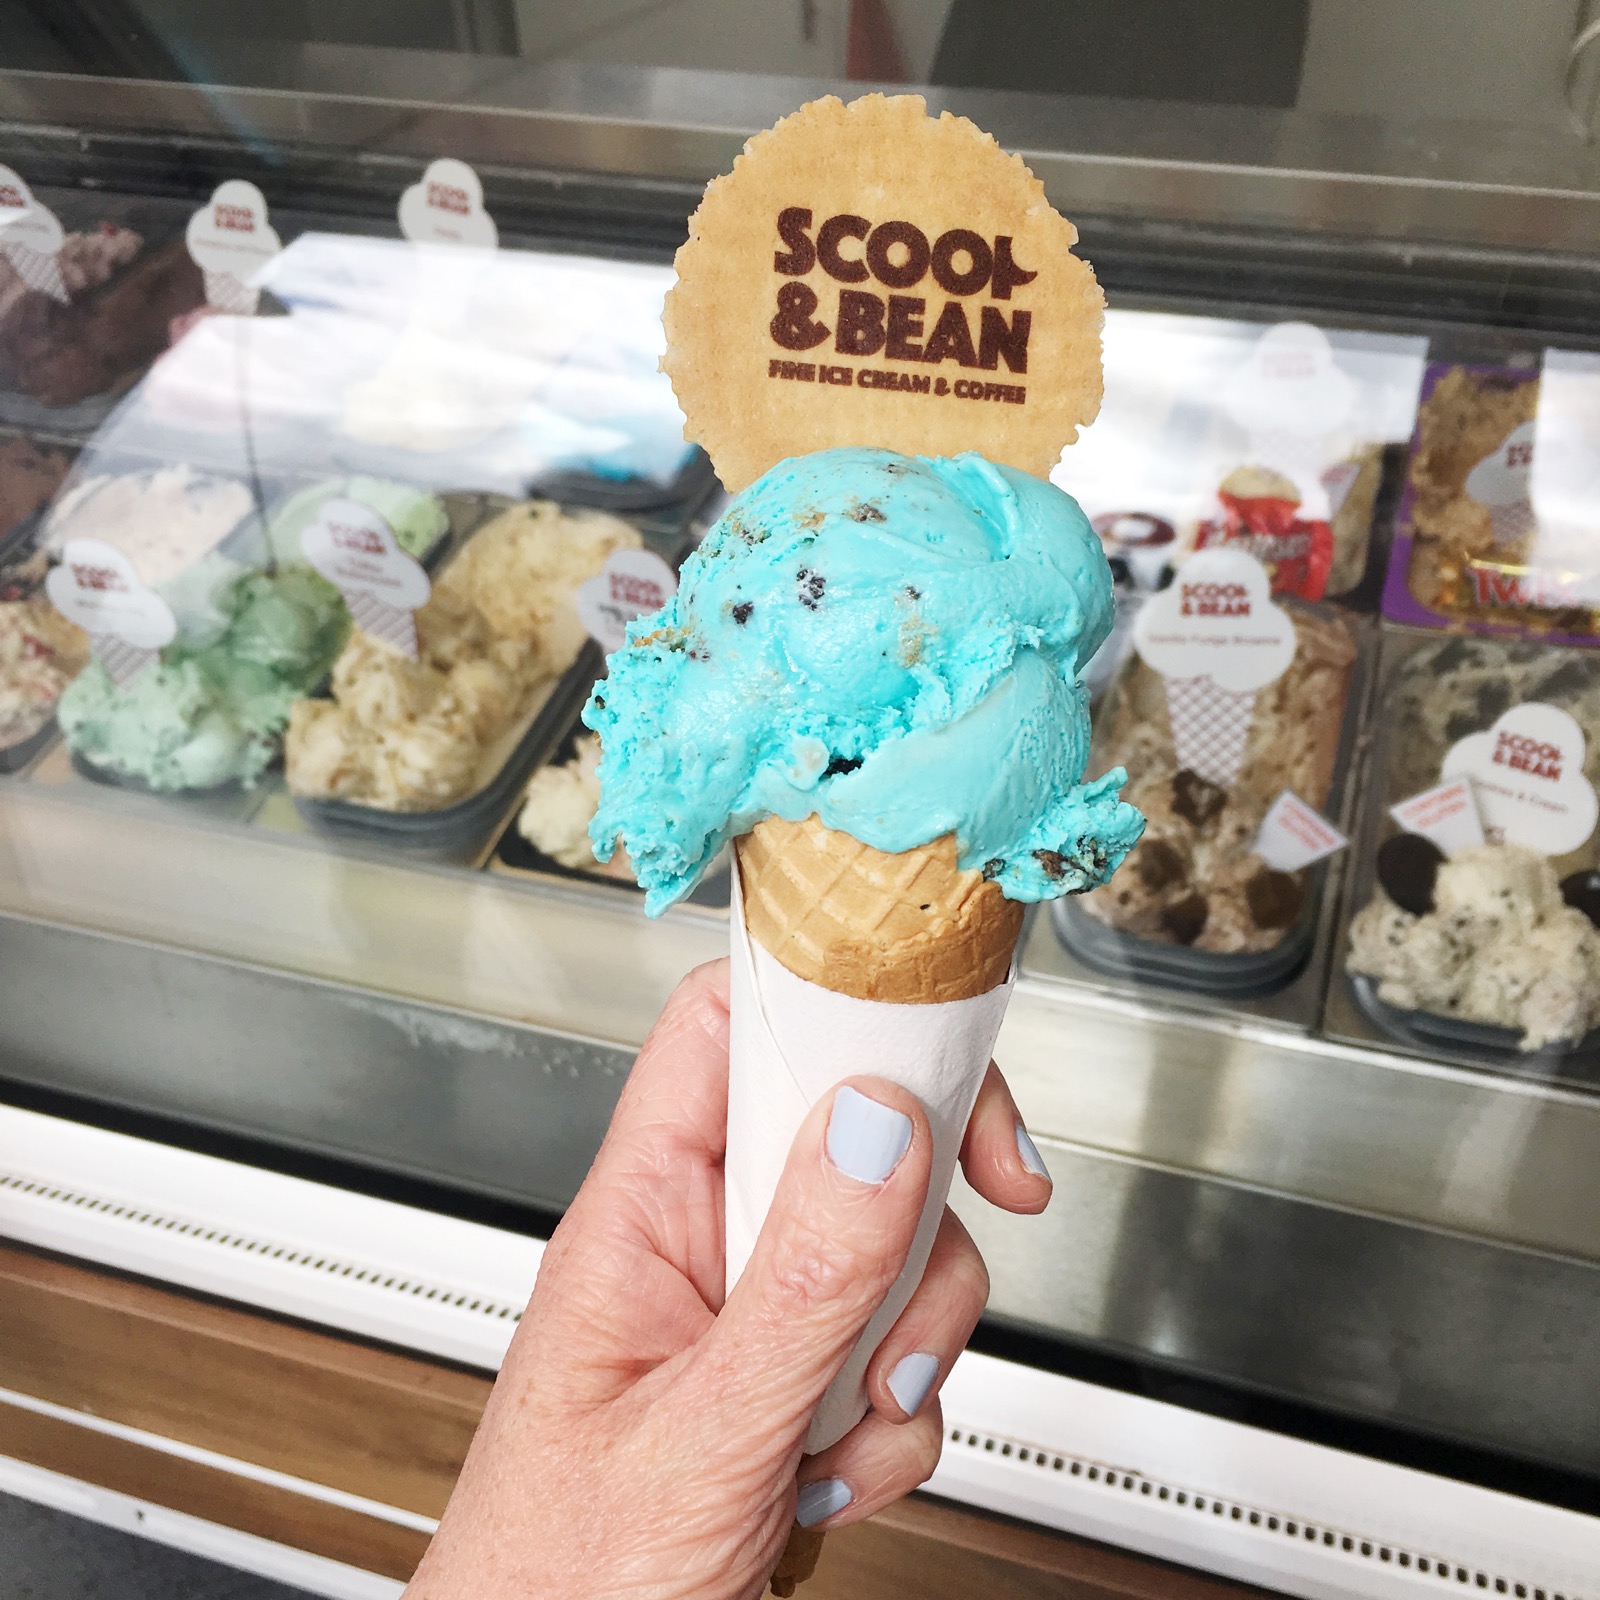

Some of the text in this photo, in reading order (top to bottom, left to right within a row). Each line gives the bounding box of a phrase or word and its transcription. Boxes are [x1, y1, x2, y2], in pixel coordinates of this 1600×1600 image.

[770, 281, 1032, 374] & BEAN
[768, 359, 1026, 405] FINE ICE CREAM & COFFEE
